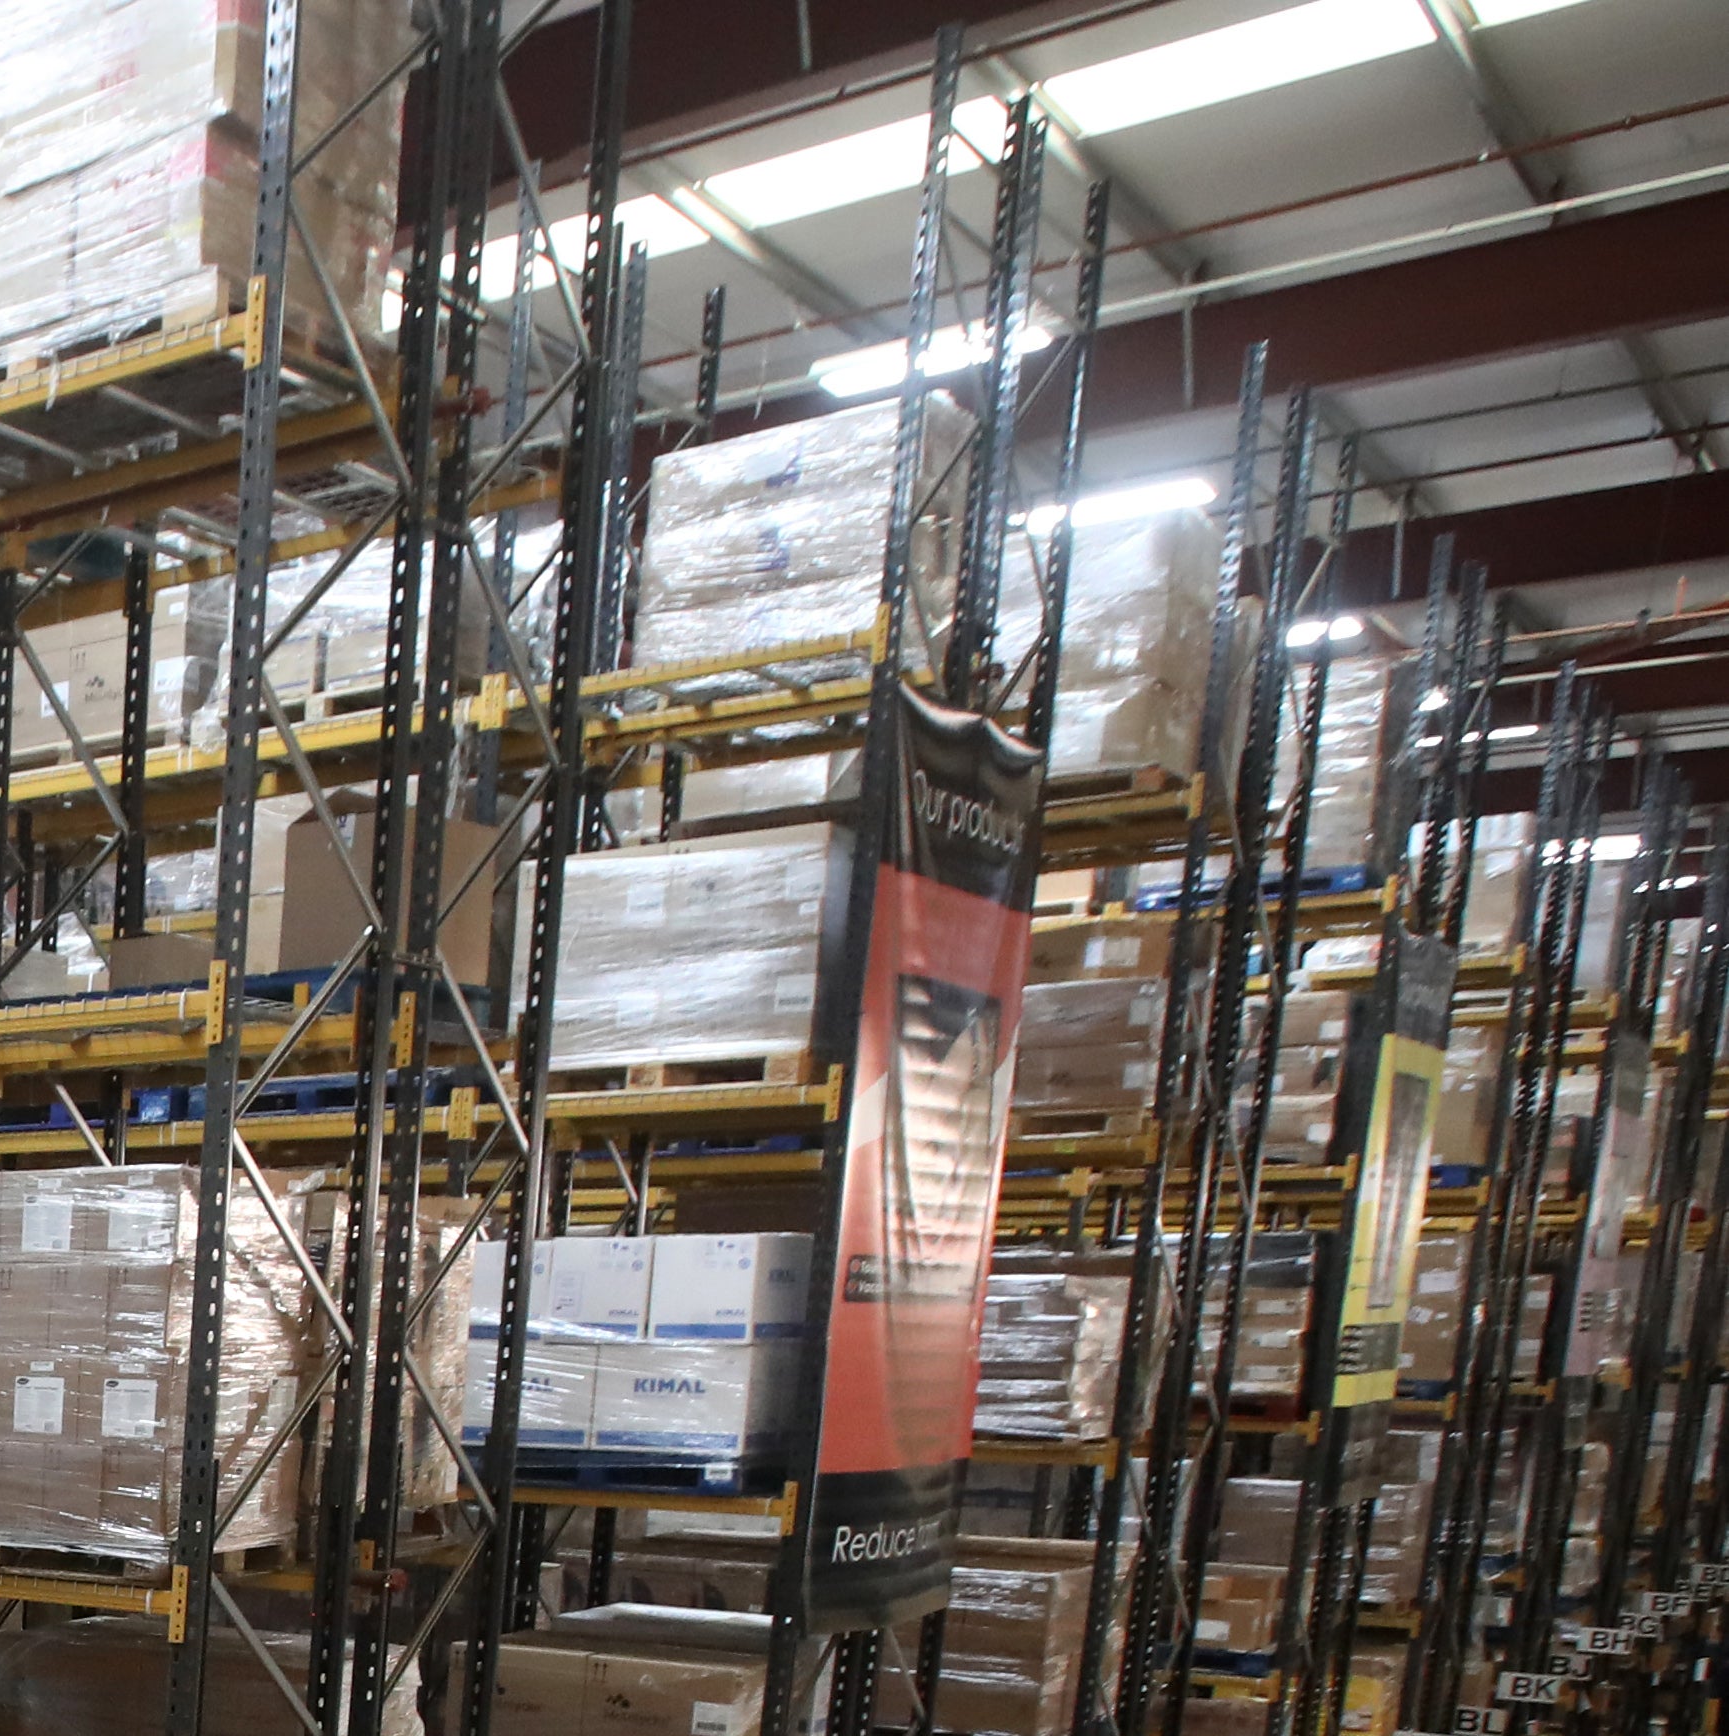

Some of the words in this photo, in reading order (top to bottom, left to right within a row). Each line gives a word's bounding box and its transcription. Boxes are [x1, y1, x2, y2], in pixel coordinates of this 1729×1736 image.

[633, 1377, 706, 1395] KIMAL
[831, 1521, 916, 1563] Reduce
[1652, 1594, 1691, 1615] BF
[1590, 1630, 1630, 1651] BH
[1511, 1675, 1557, 1700] BK
[1457, 1709, 1503, 1734] BL
